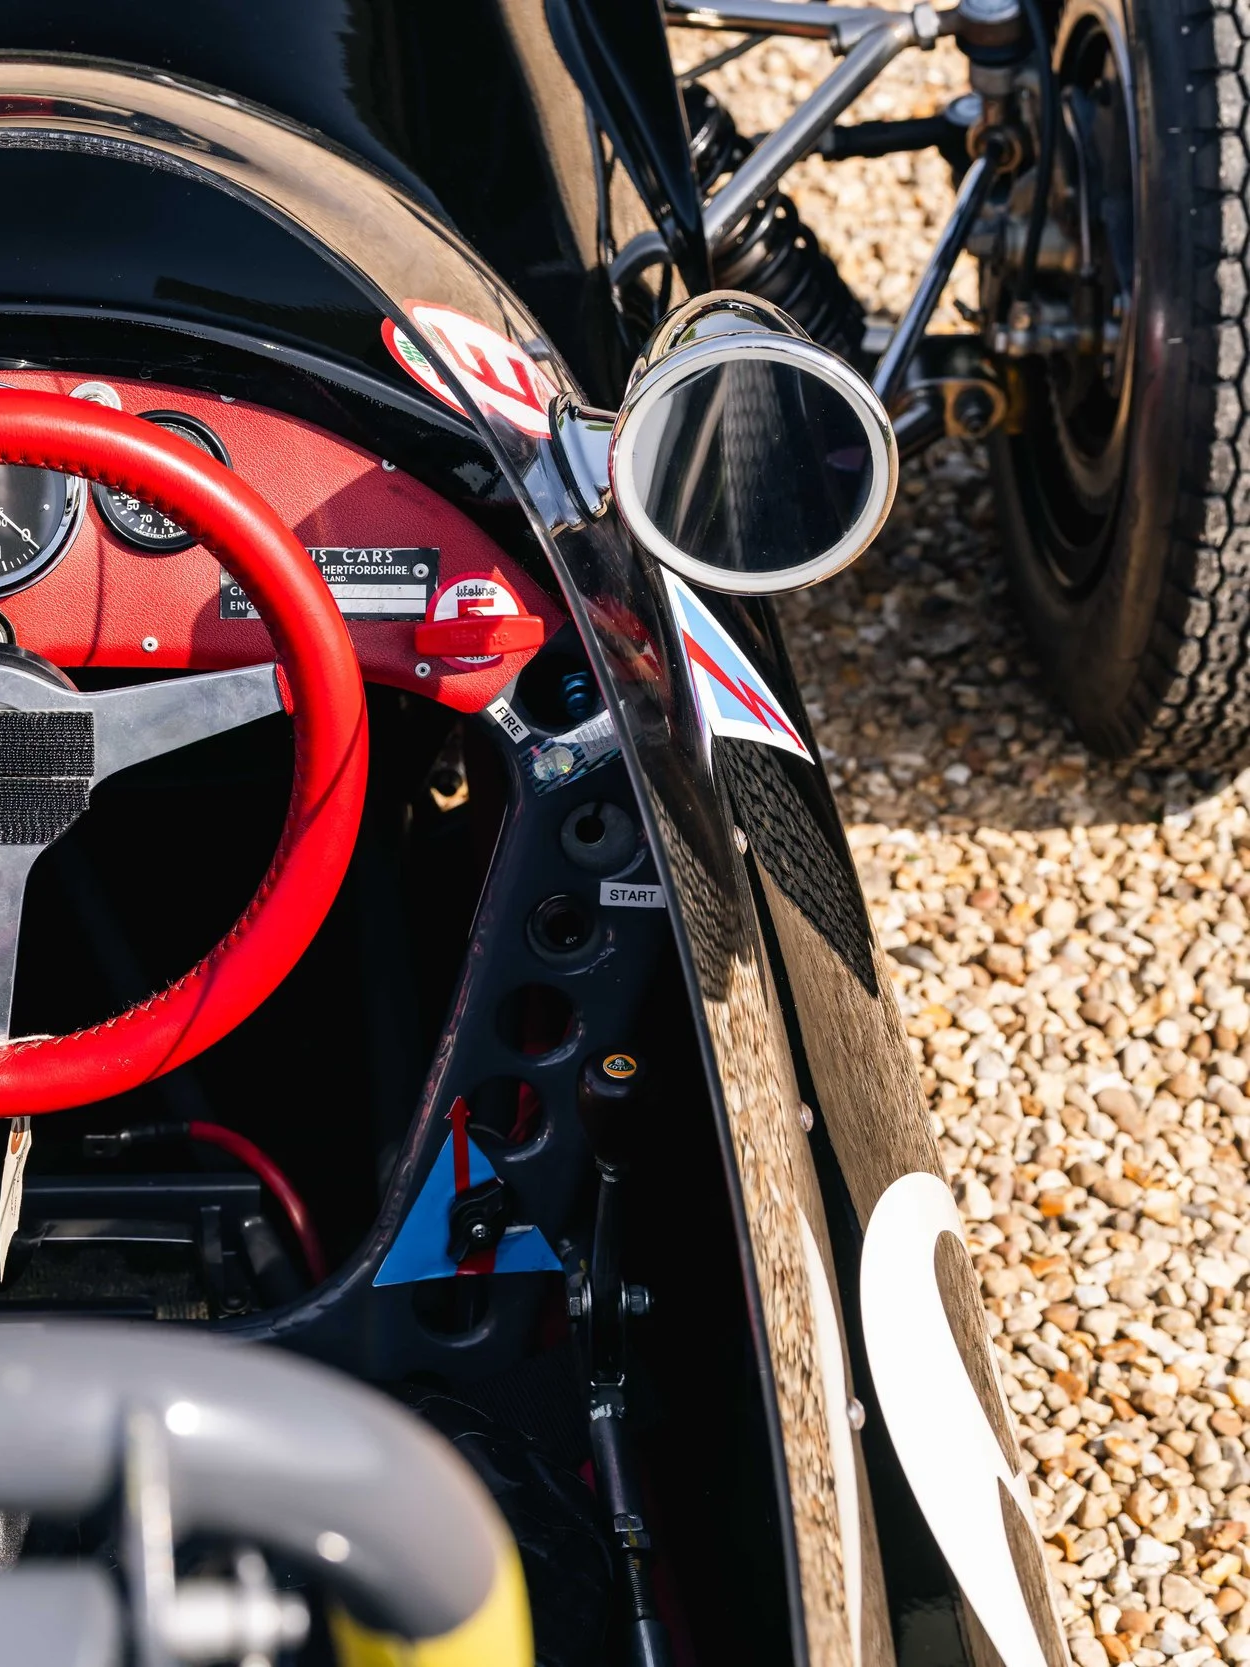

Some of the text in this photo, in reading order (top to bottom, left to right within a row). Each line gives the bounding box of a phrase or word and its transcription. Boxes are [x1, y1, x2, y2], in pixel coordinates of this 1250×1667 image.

[126, 502, 140, 511] 50
[140, 514, 153, 523] 70
[21, 528, 31, 542] 0
[342, 549, 393, 563] CARS
[322, 565, 410, 575] HERTFORDSHIRE.
[495, 706, 524, 737] FIRE
[609, 888, 657, 902] START
